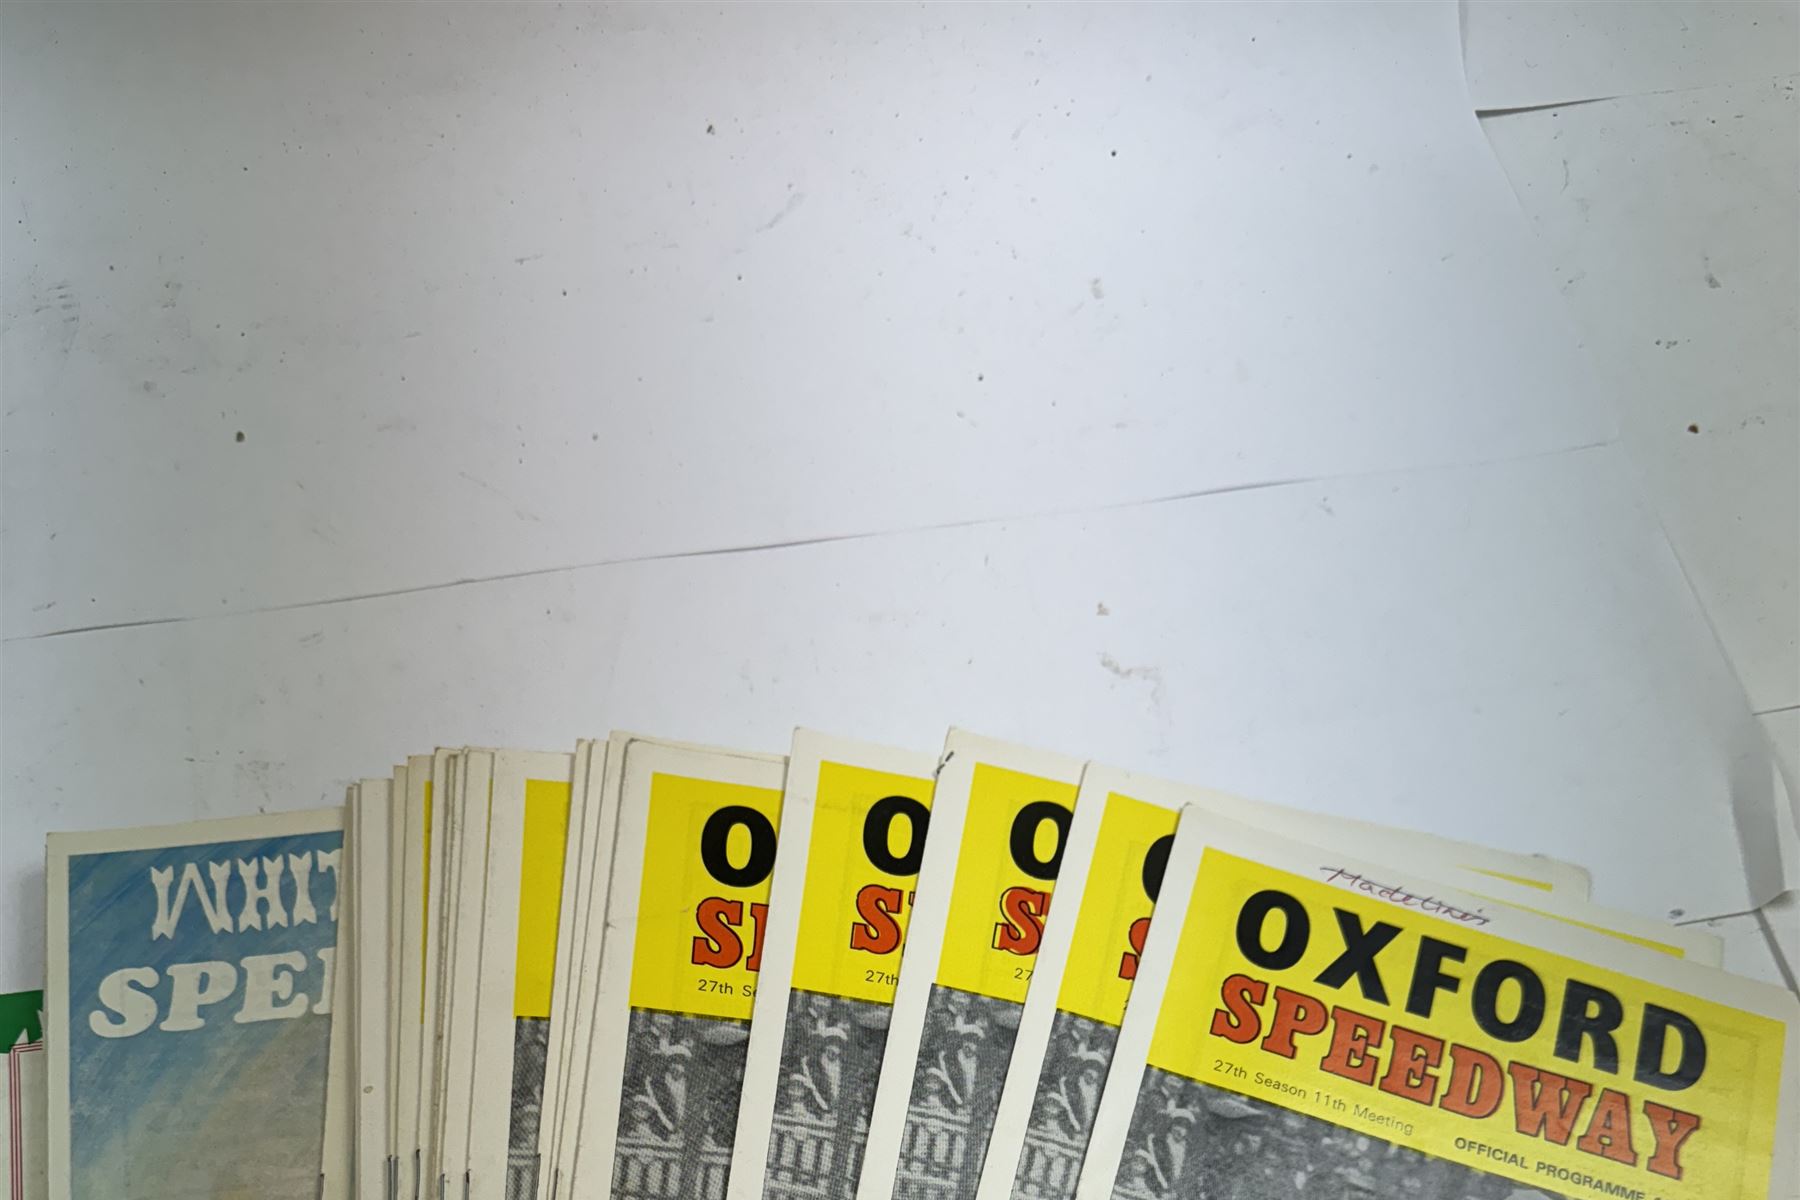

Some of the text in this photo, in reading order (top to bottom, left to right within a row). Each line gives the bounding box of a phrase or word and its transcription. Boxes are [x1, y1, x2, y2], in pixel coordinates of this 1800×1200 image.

[701, 805, 778, 888] O
[862, 795, 932, 877] O
[1009, 801, 1074, 881] O
[850, 884, 915, 956] S
[698, 979, 734, 995] 27th
[865, 970, 899, 986] 27th
[1235, 889, 1707, 1092] OXFORD
[1209, 974, 1700, 1181] SPEEDWAY
[1213, 1058, 1414, 1136] 27th Season 11th Meeting
[1454, 1136, 1529, 1171] OFFICIAL
